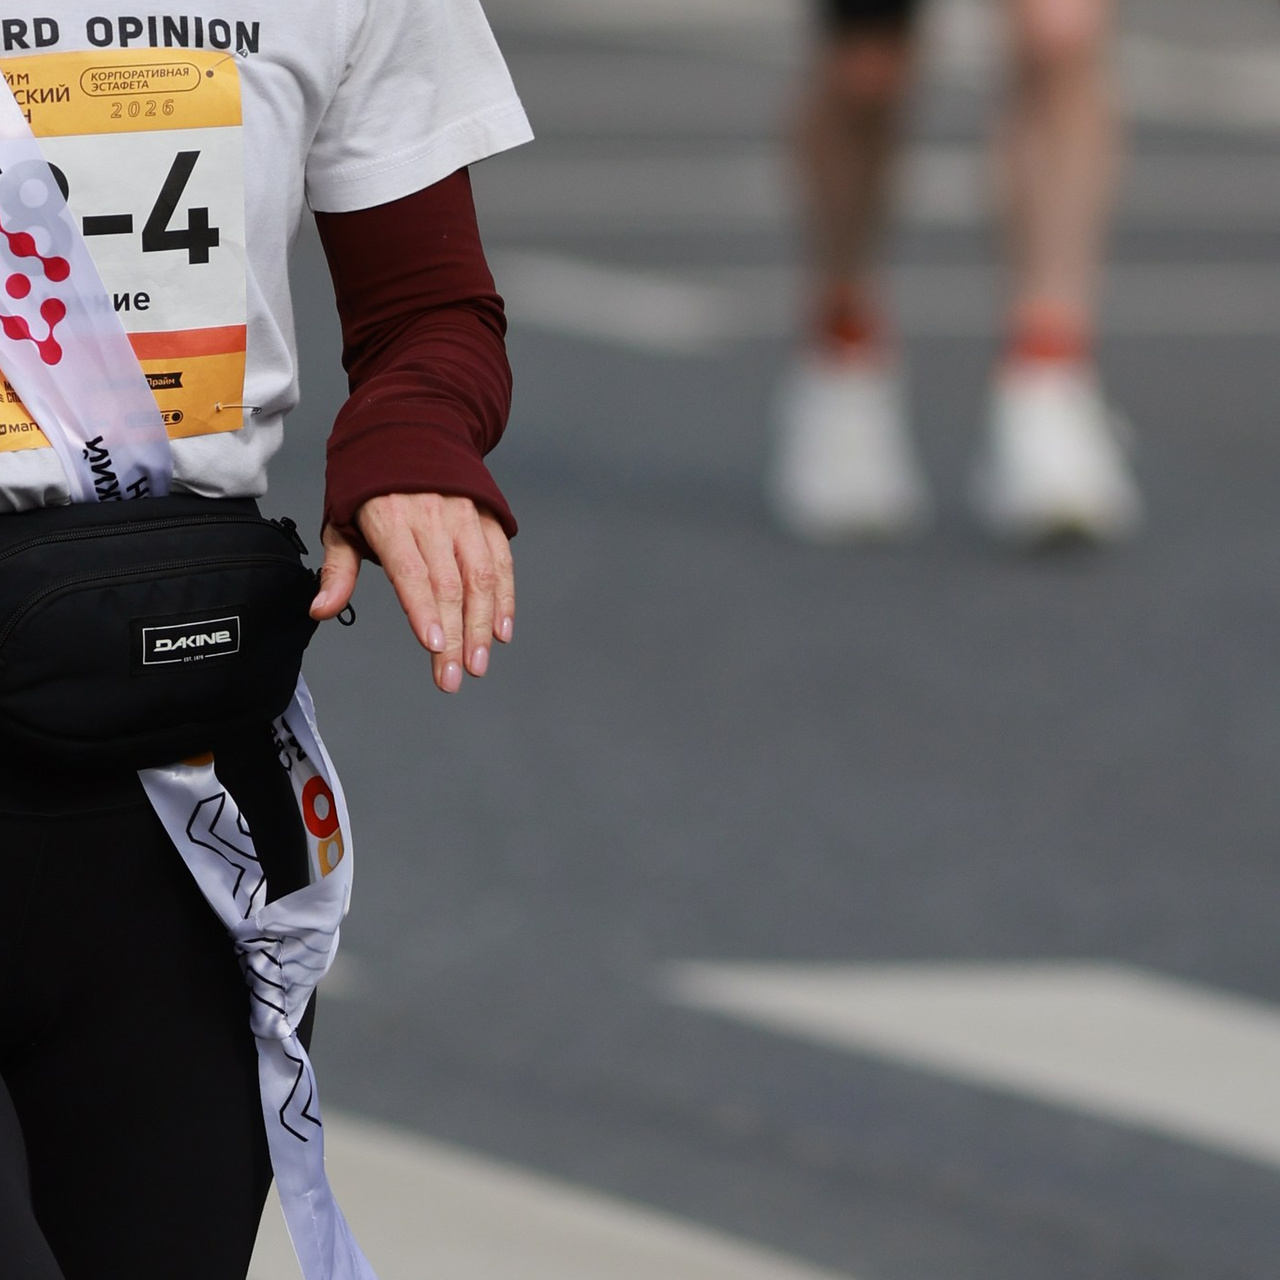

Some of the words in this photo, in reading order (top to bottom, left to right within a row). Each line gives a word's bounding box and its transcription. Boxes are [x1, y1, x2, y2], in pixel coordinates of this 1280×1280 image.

[86, 15, 260, 53] OPINION
[91, 67, 190, 81] КОРПОРАТИВНАЯ
[13, 83, 71, 106] СКИЙ
[91, 80, 150, 92] ЭСТАФЕТА
[153, 631, 232, 652] DAKINE
